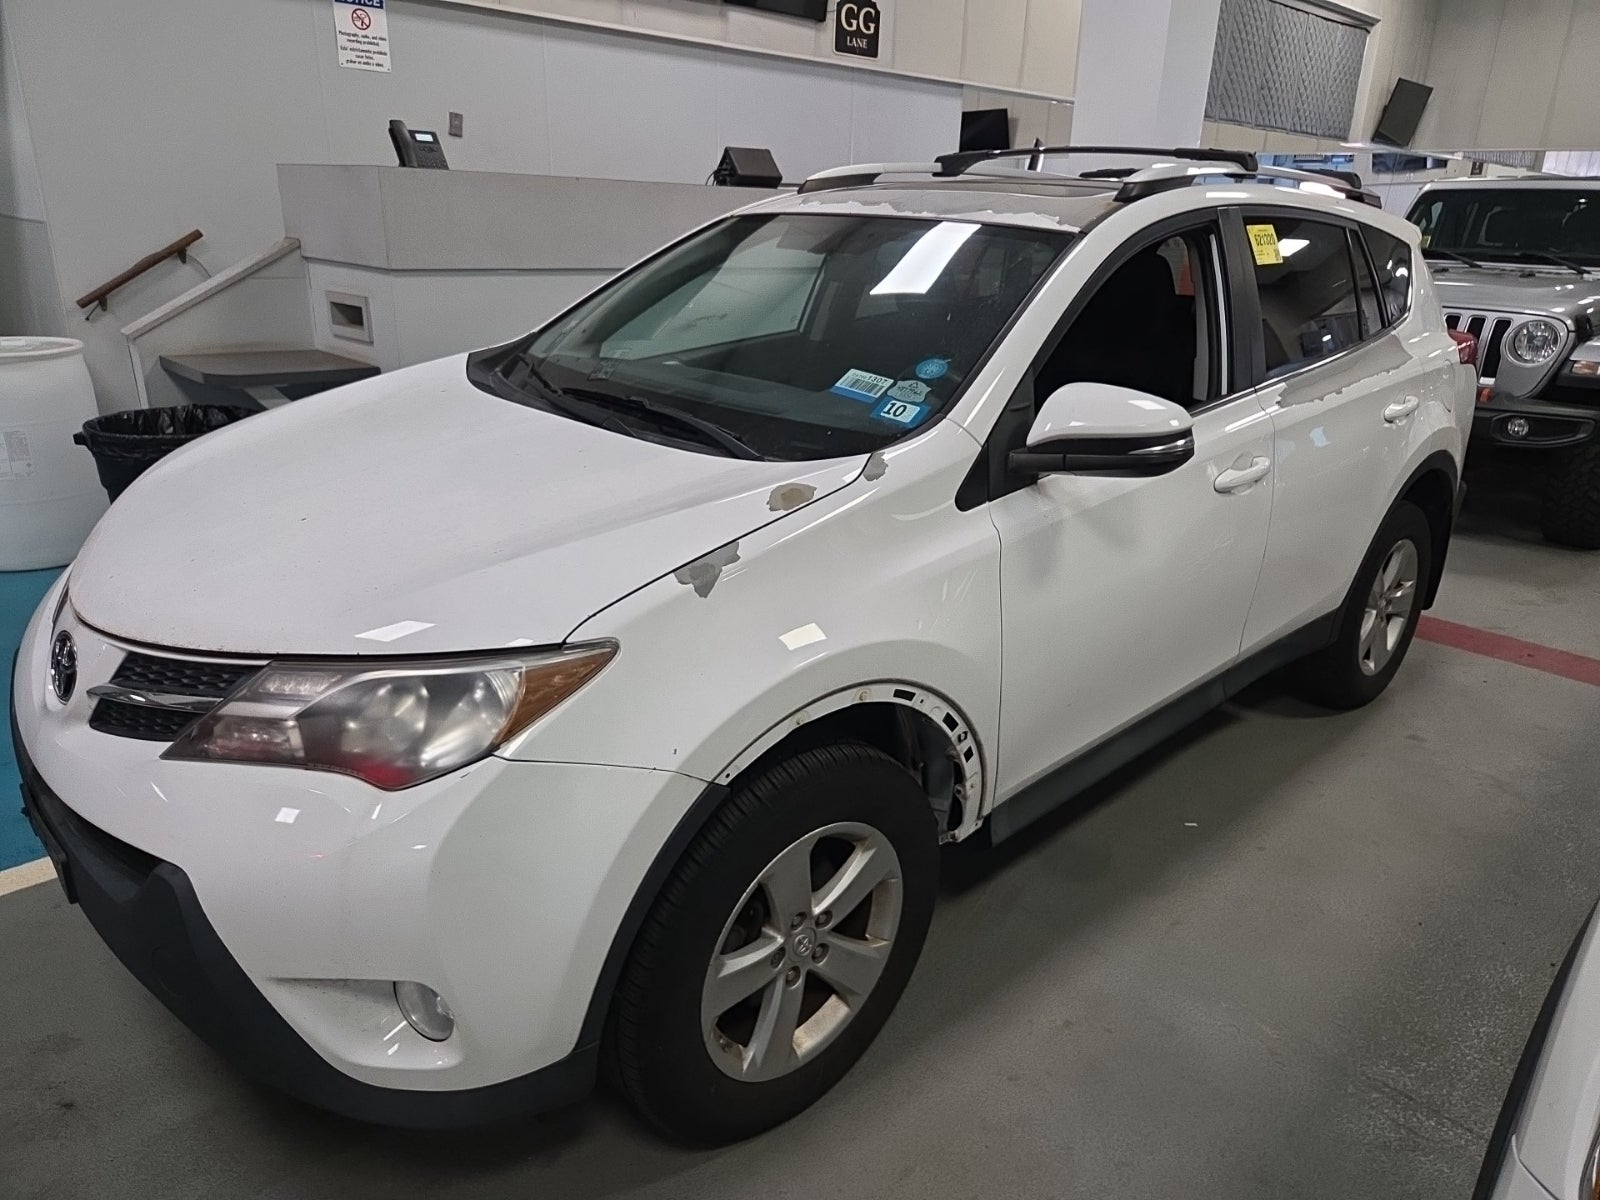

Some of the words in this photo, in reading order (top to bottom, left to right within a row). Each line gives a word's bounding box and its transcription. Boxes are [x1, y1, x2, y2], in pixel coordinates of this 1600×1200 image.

[841, 3, 875, 34] GG
[847, 36, 867, 48] LANE
[883, 402, 908, 417] 10
